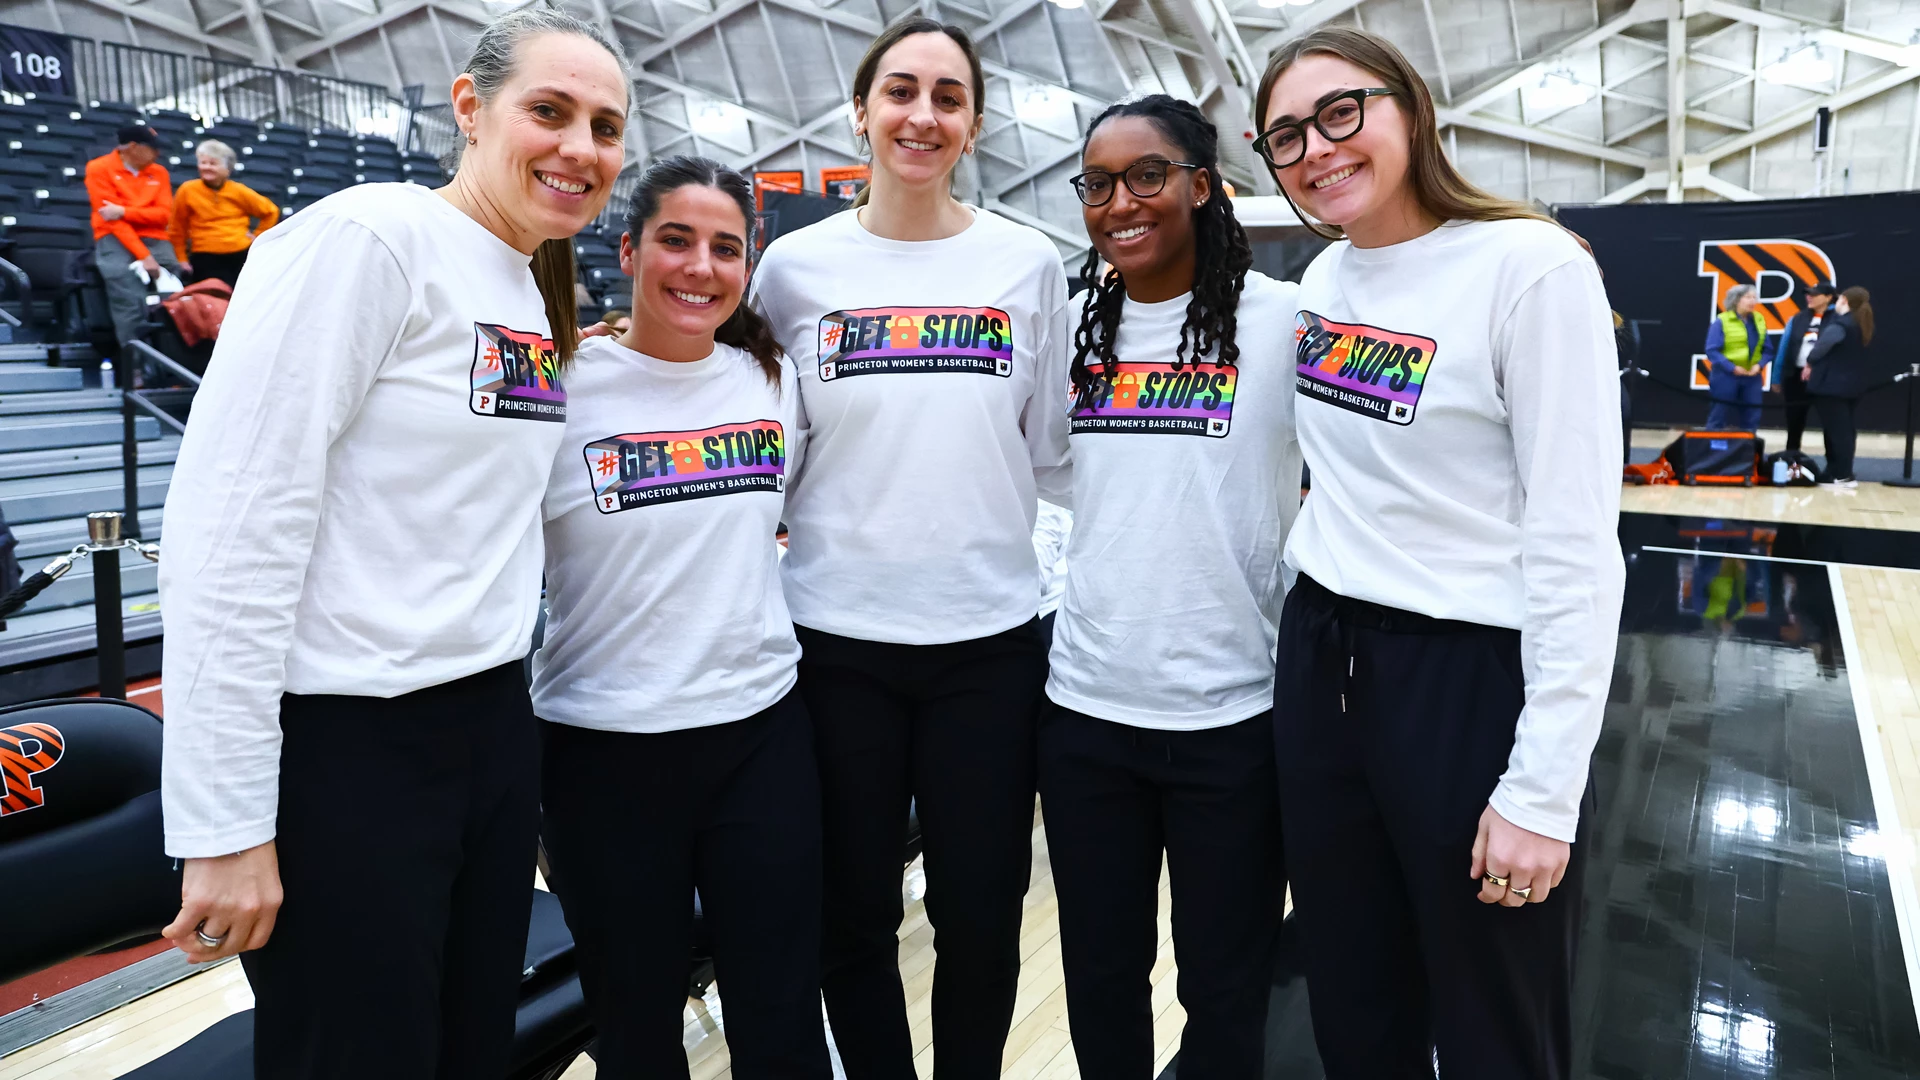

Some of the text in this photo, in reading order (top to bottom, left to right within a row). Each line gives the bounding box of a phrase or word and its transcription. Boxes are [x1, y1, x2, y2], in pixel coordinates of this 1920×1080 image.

[10, 50, 62, 80] 108
[824, 314, 1004, 353] #GET STOPS
[483, 336, 535, 388] #GET
[838, 358, 994, 372] PRINCETON WOMEN'S BASKETBALL
[1338, 334, 1423, 392] STOPS
[498, 399, 536, 412] PRINCETON
[1138, 371, 1228, 411] STOPS
[1312, 382, 1338, 399] WOMEN'S
[1339, 391, 1386, 413] BASKETBALL
[1072, 419, 1107, 428] PRINCETON
[1109, 419, 1146, 428] WOMEN'S
[1148, 419, 1205, 430] BASKETBALL
[597, 428, 780, 482] #GET STOPS
[622, 476, 776, 504] PRINCETON WOMEN'S BASKETBALL
